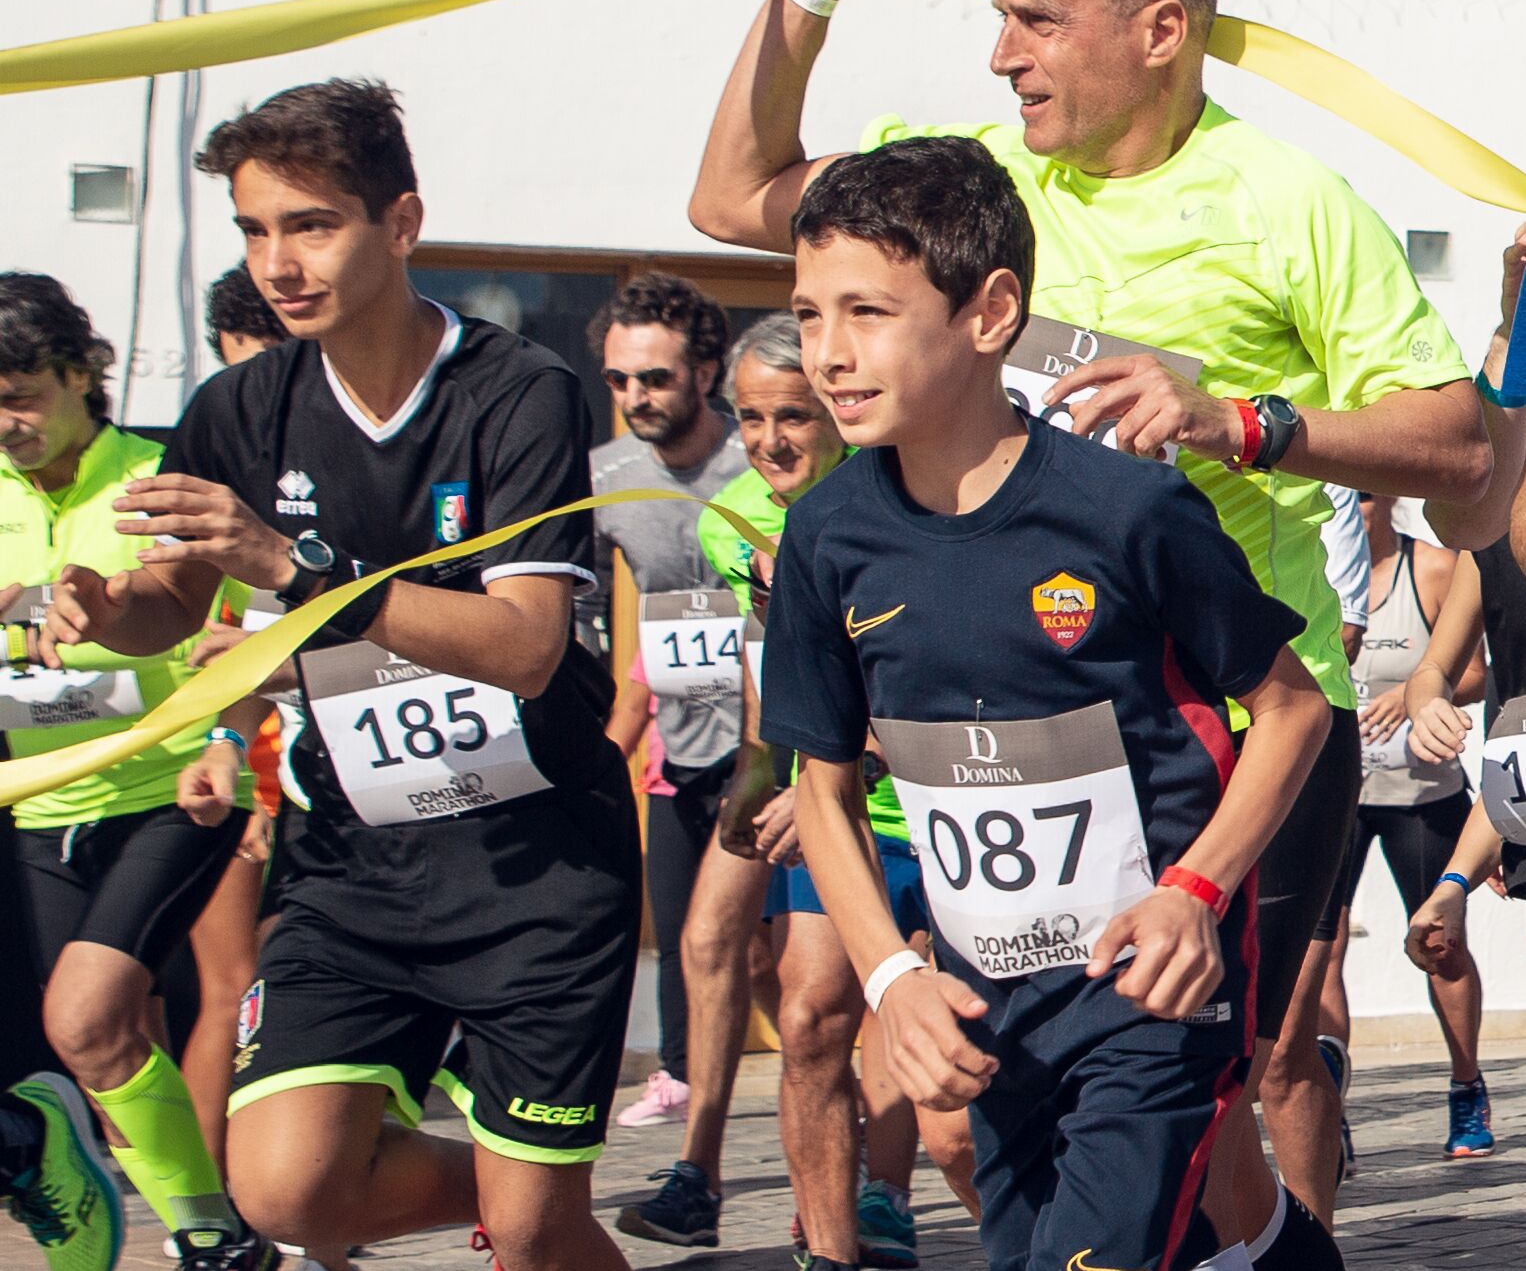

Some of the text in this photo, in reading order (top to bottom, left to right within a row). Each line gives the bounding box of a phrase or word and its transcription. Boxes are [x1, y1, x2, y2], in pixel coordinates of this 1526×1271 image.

[1042, 615, 1087, 628] ROMA
[661, 629, 742, 668] 114
[353, 686, 489, 769] 185
[951, 763, 1024, 784] DOMINA
[407, 784, 478, 807] DOMINA
[415, 791, 498, 817] MARATHON
[928, 798, 1093, 892] 087
[974, 929, 1069, 956] DOMINA
[978, 943, 1090, 974] MARATHON
[507, 1096, 597, 1125] LEGEA
